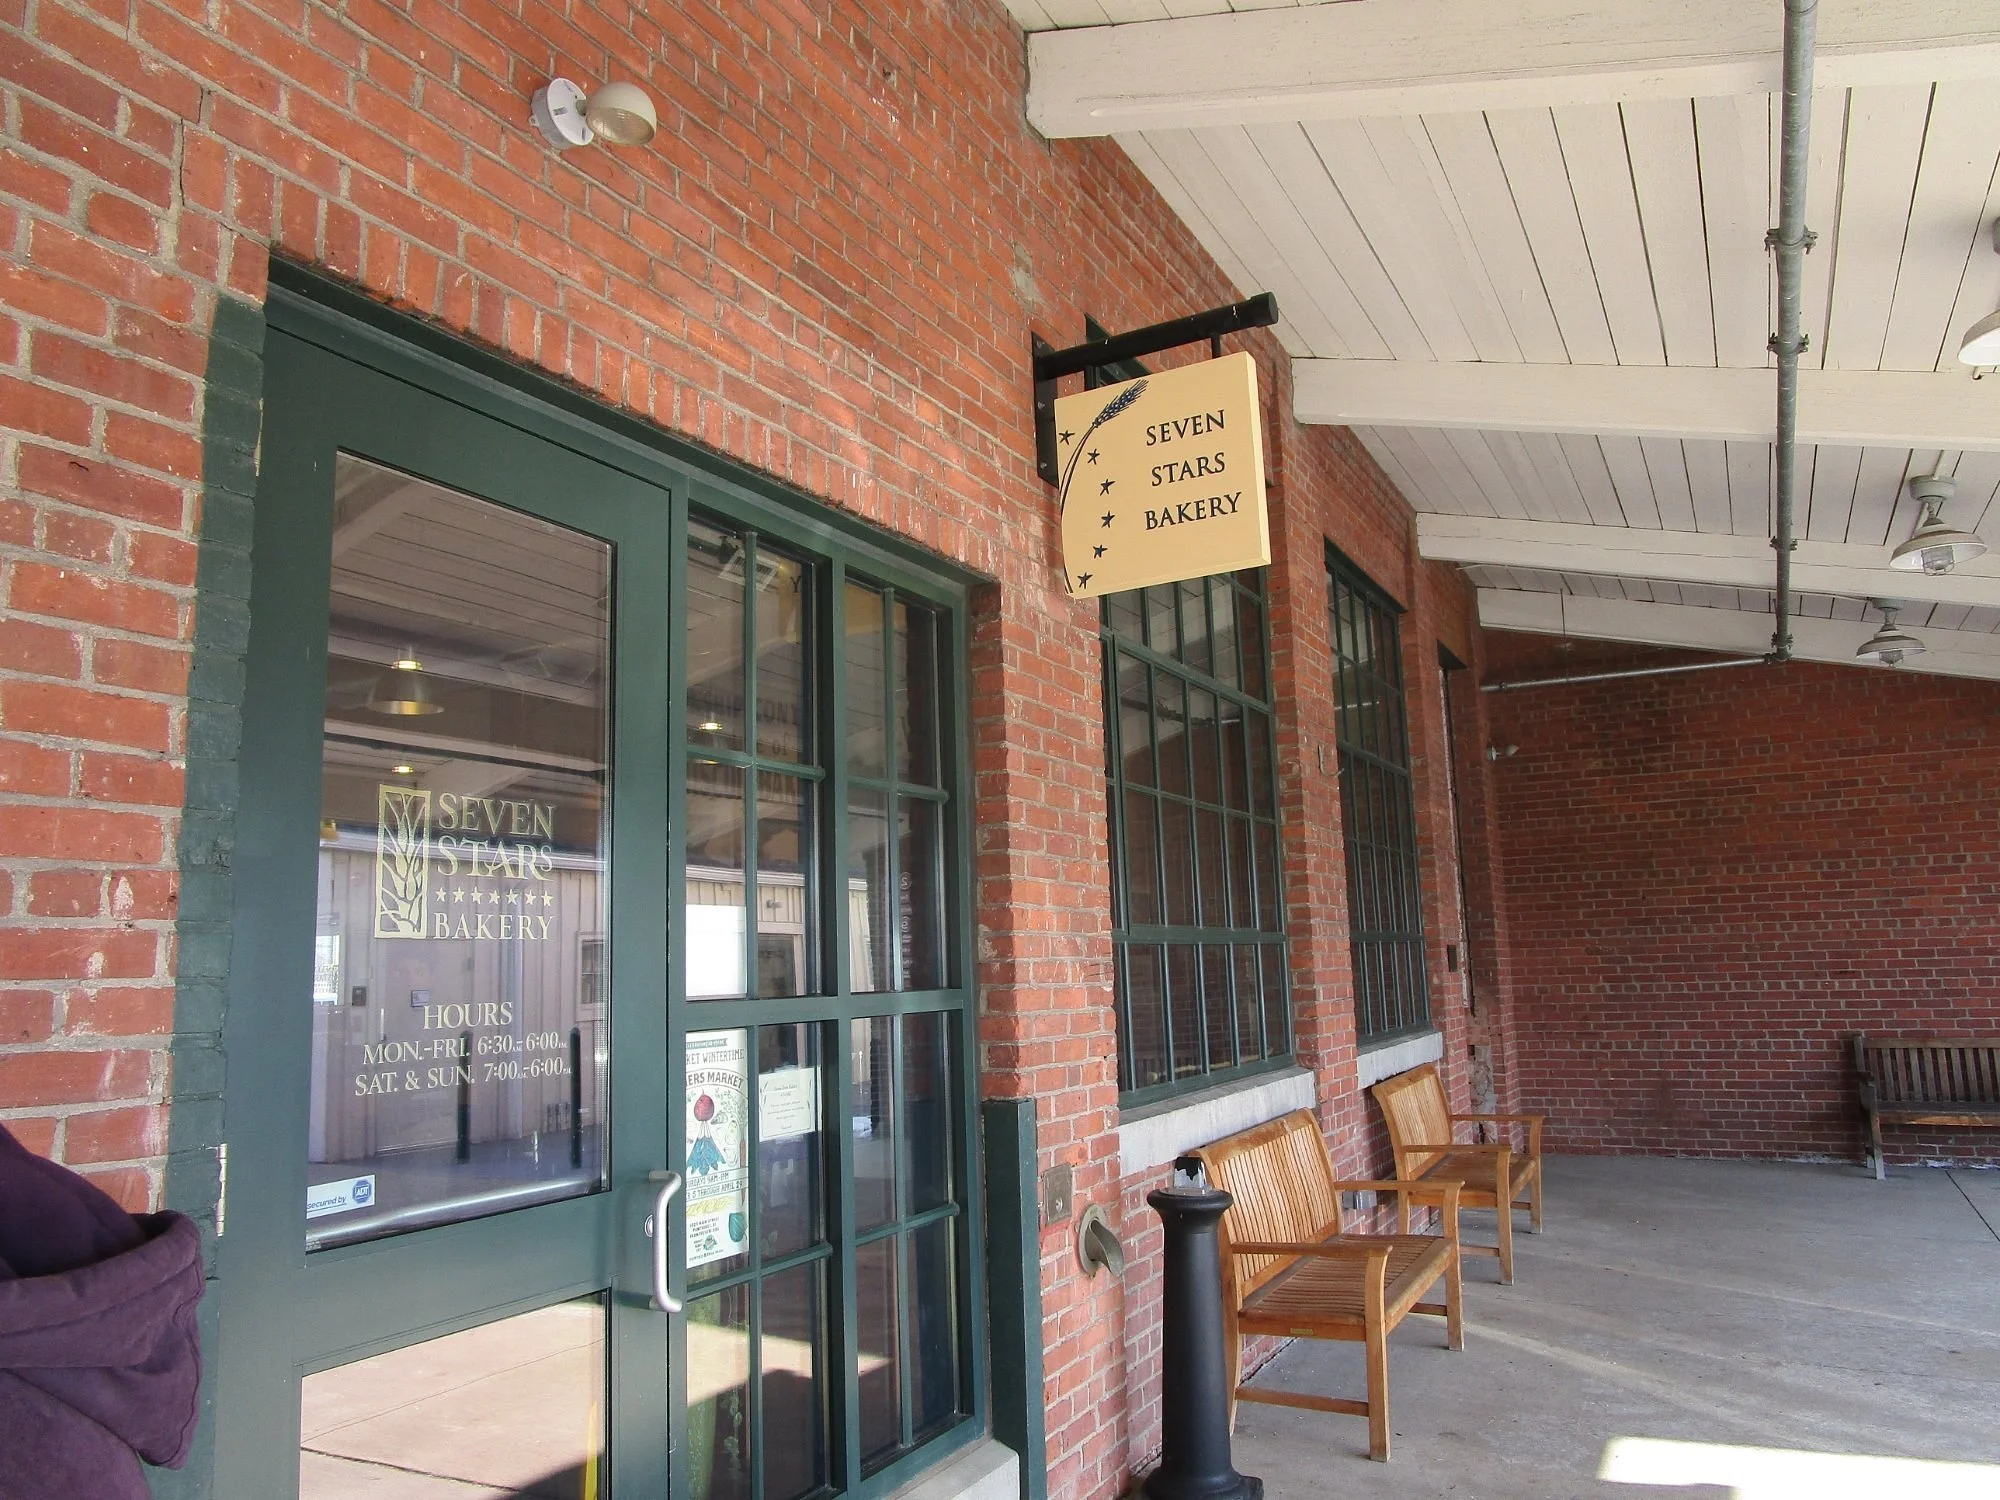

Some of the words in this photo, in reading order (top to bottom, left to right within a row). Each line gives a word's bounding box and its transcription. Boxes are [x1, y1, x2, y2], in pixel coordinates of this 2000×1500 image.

[1146, 409, 1225, 446] SEVEN
[1151, 452, 1226, 487] STARS
[1144, 491, 1242, 530] BAKERY
[438, 792, 557, 840] SEVEN
[437, 834, 555, 882] STARS
[433, 911, 555, 940] BAKERY
[423, 1001, 513, 1030] HOURS
[702, 1049, 744, 1063] WINTERTIME
[355, 1071, 398, 1096] SAT.
[405, 1070, 421, 1091] &
[427, 1064, 475, 1089] SUN.
[686, 1072, 705, 1087] ERS
[707, 1071, 744, 1088] MARKET
[307, 1197, 337, 1210] secured
[338, 1195, 347, 1204] by
[355, 1185, 369, 1197] ADT
[721, 1181, 735, 1192] APRIL
